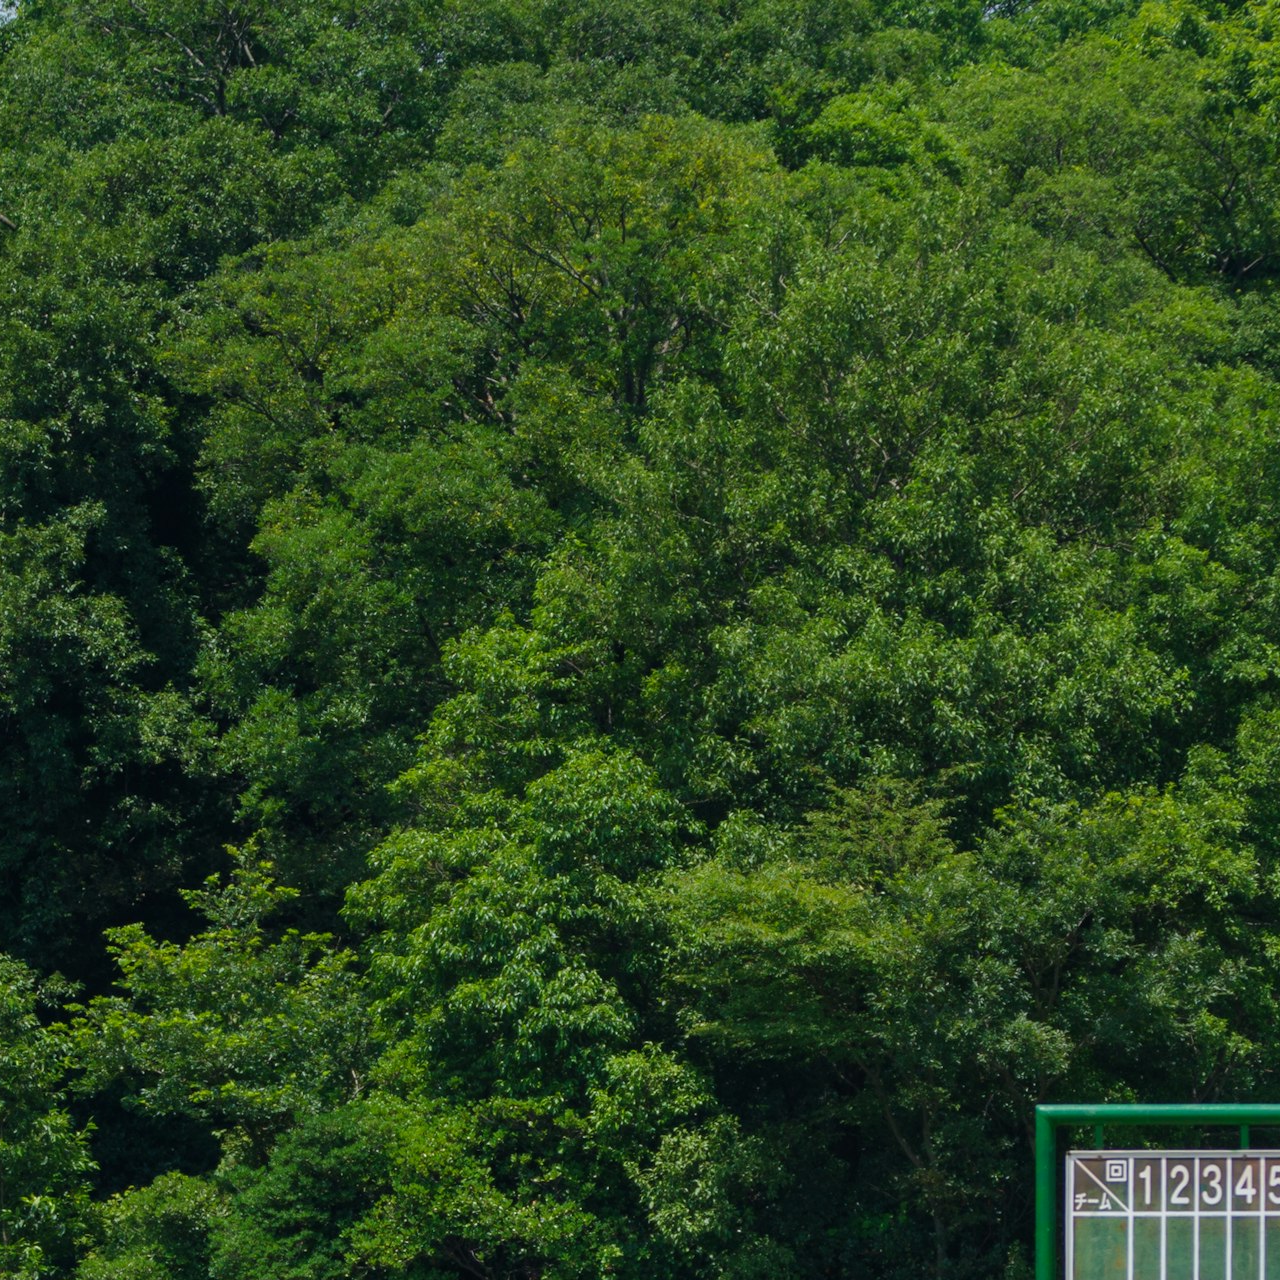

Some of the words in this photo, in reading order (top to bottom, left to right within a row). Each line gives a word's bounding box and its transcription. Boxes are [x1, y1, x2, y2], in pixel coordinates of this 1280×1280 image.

[1106, 1160, 1127, 1182] 回
[1139, 1165, 1151, 1204] 1
[1170, 1164, 1190, 1204] 2
[1202, 1164, 1222, 1204] 3
[1235, 1165, 1256, 1203] 4
[1074, 1192, 1112, 1210] チーム
